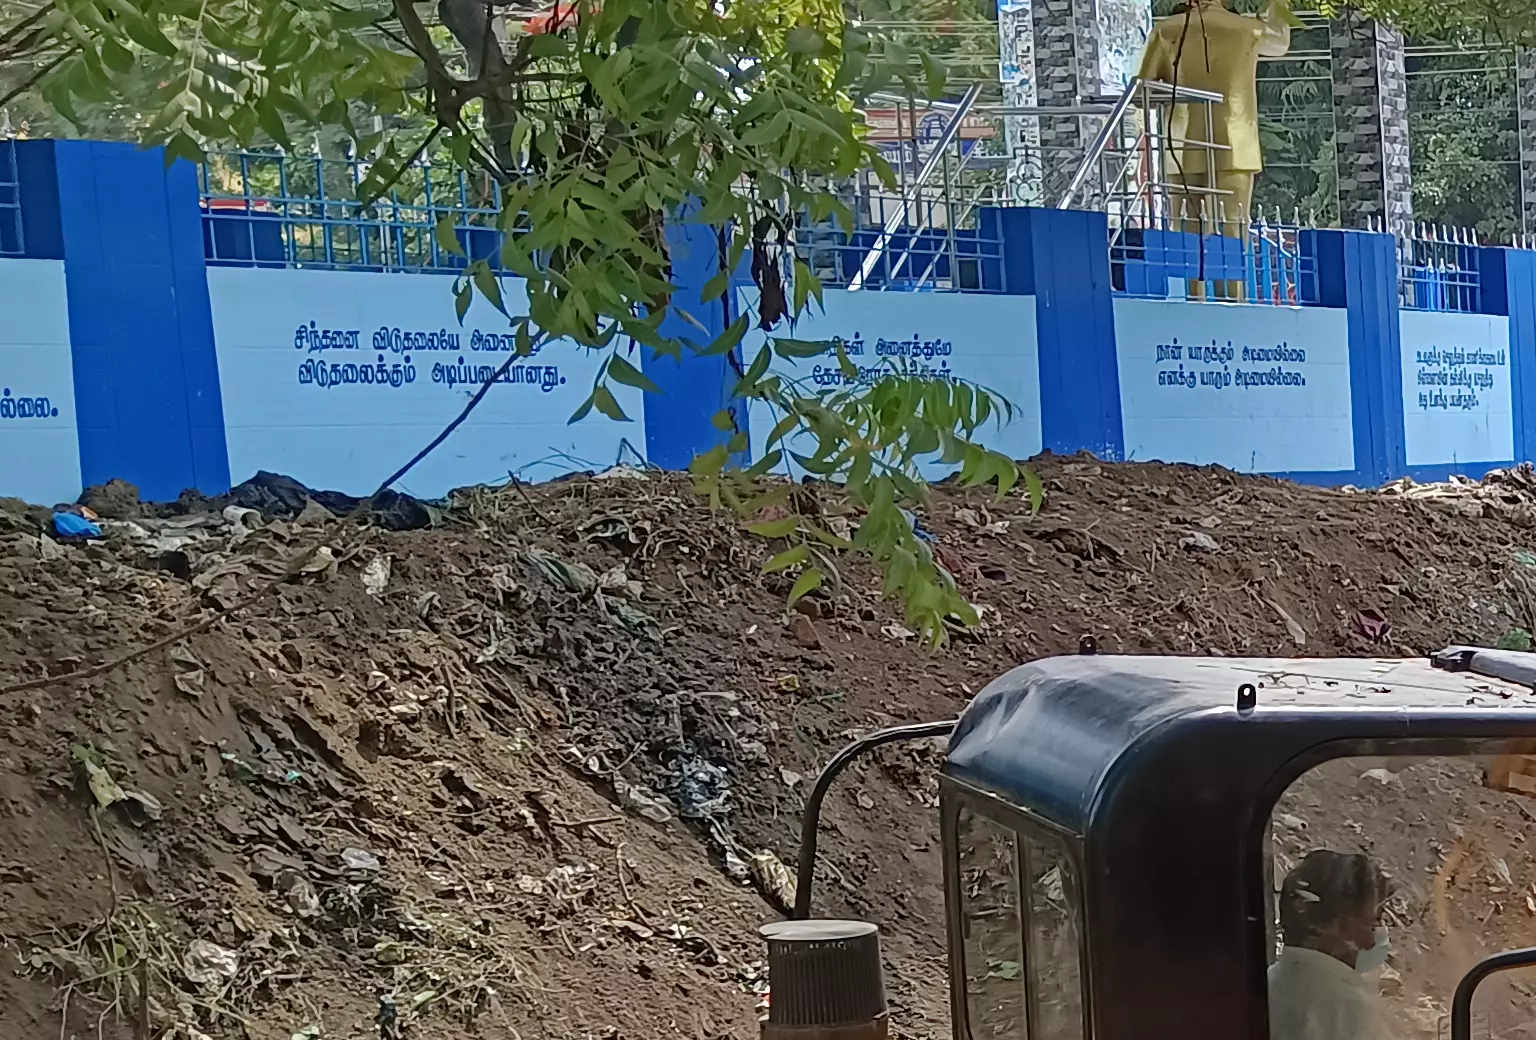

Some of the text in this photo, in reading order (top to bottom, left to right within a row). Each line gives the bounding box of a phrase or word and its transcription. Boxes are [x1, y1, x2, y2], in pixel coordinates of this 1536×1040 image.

[294, 320, 360, 354] சிந்தனை
[372, 326, 460, 354] விடுதலையே
[1156, 337, 1183, 364] நான்
[298, 354, 566, 392] விடுதலைக்கும் அடிப்படையானது.
